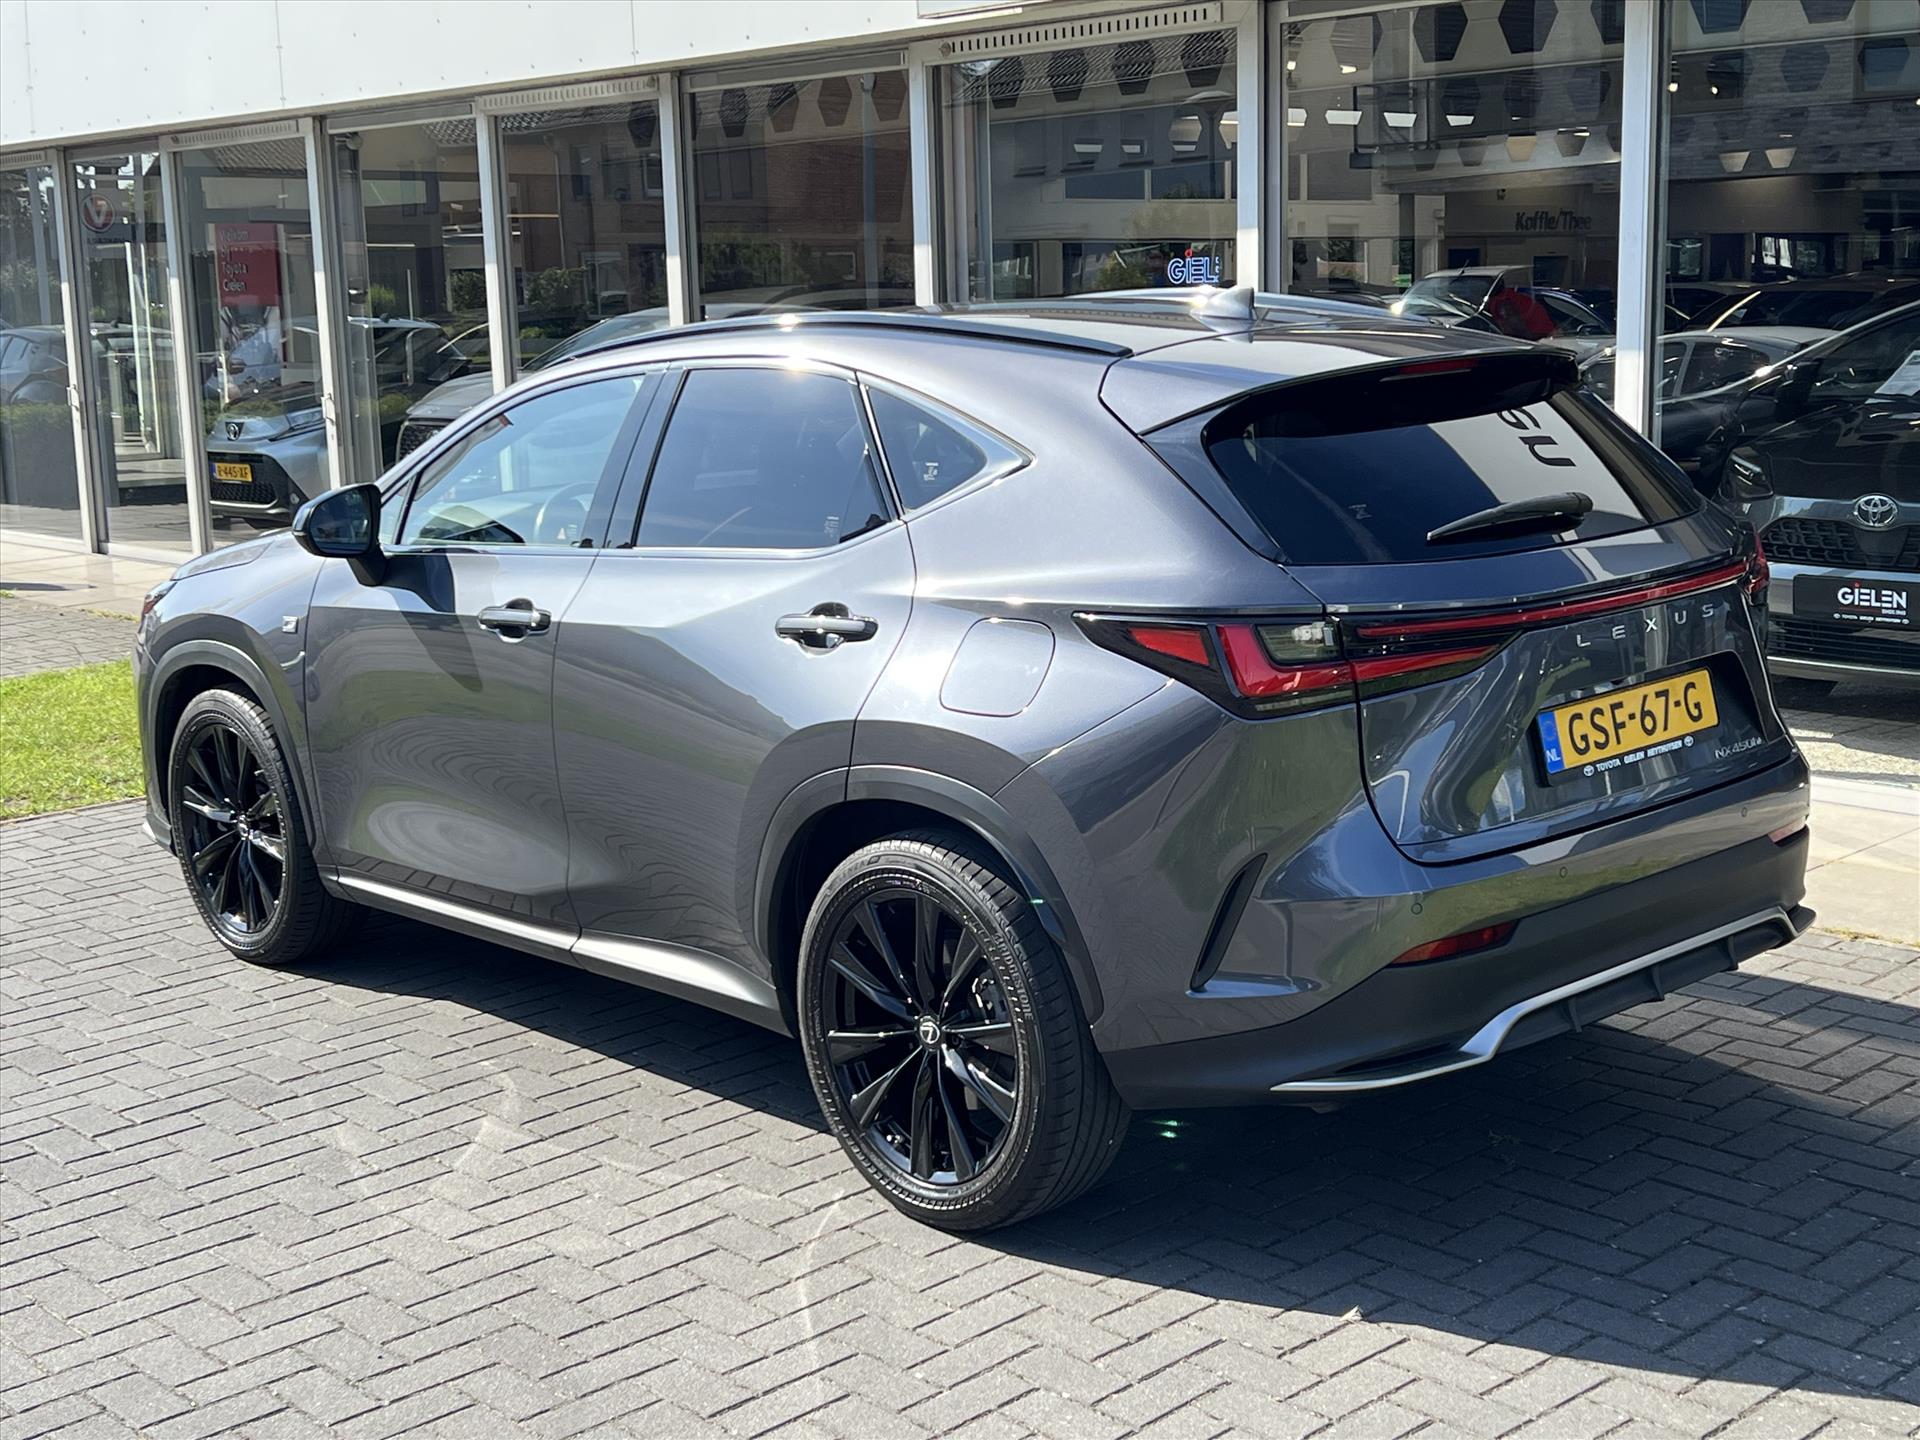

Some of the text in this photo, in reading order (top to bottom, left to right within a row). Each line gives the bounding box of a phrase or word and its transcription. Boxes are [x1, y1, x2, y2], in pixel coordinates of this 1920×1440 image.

[1837, 582, 1907, 608] GIELEN
[1576, 604, 1714, 648] LEXUS
[1568, 681, 1703, 756] GSF-67-G
[1545, 748, 1561, 763] NL
[1596, 758, 1621, 772] TOYOTA
[1624, 751, 1645, 764] GIELEN
[994, 932, 1034, 1021] BRIDGESTONE
